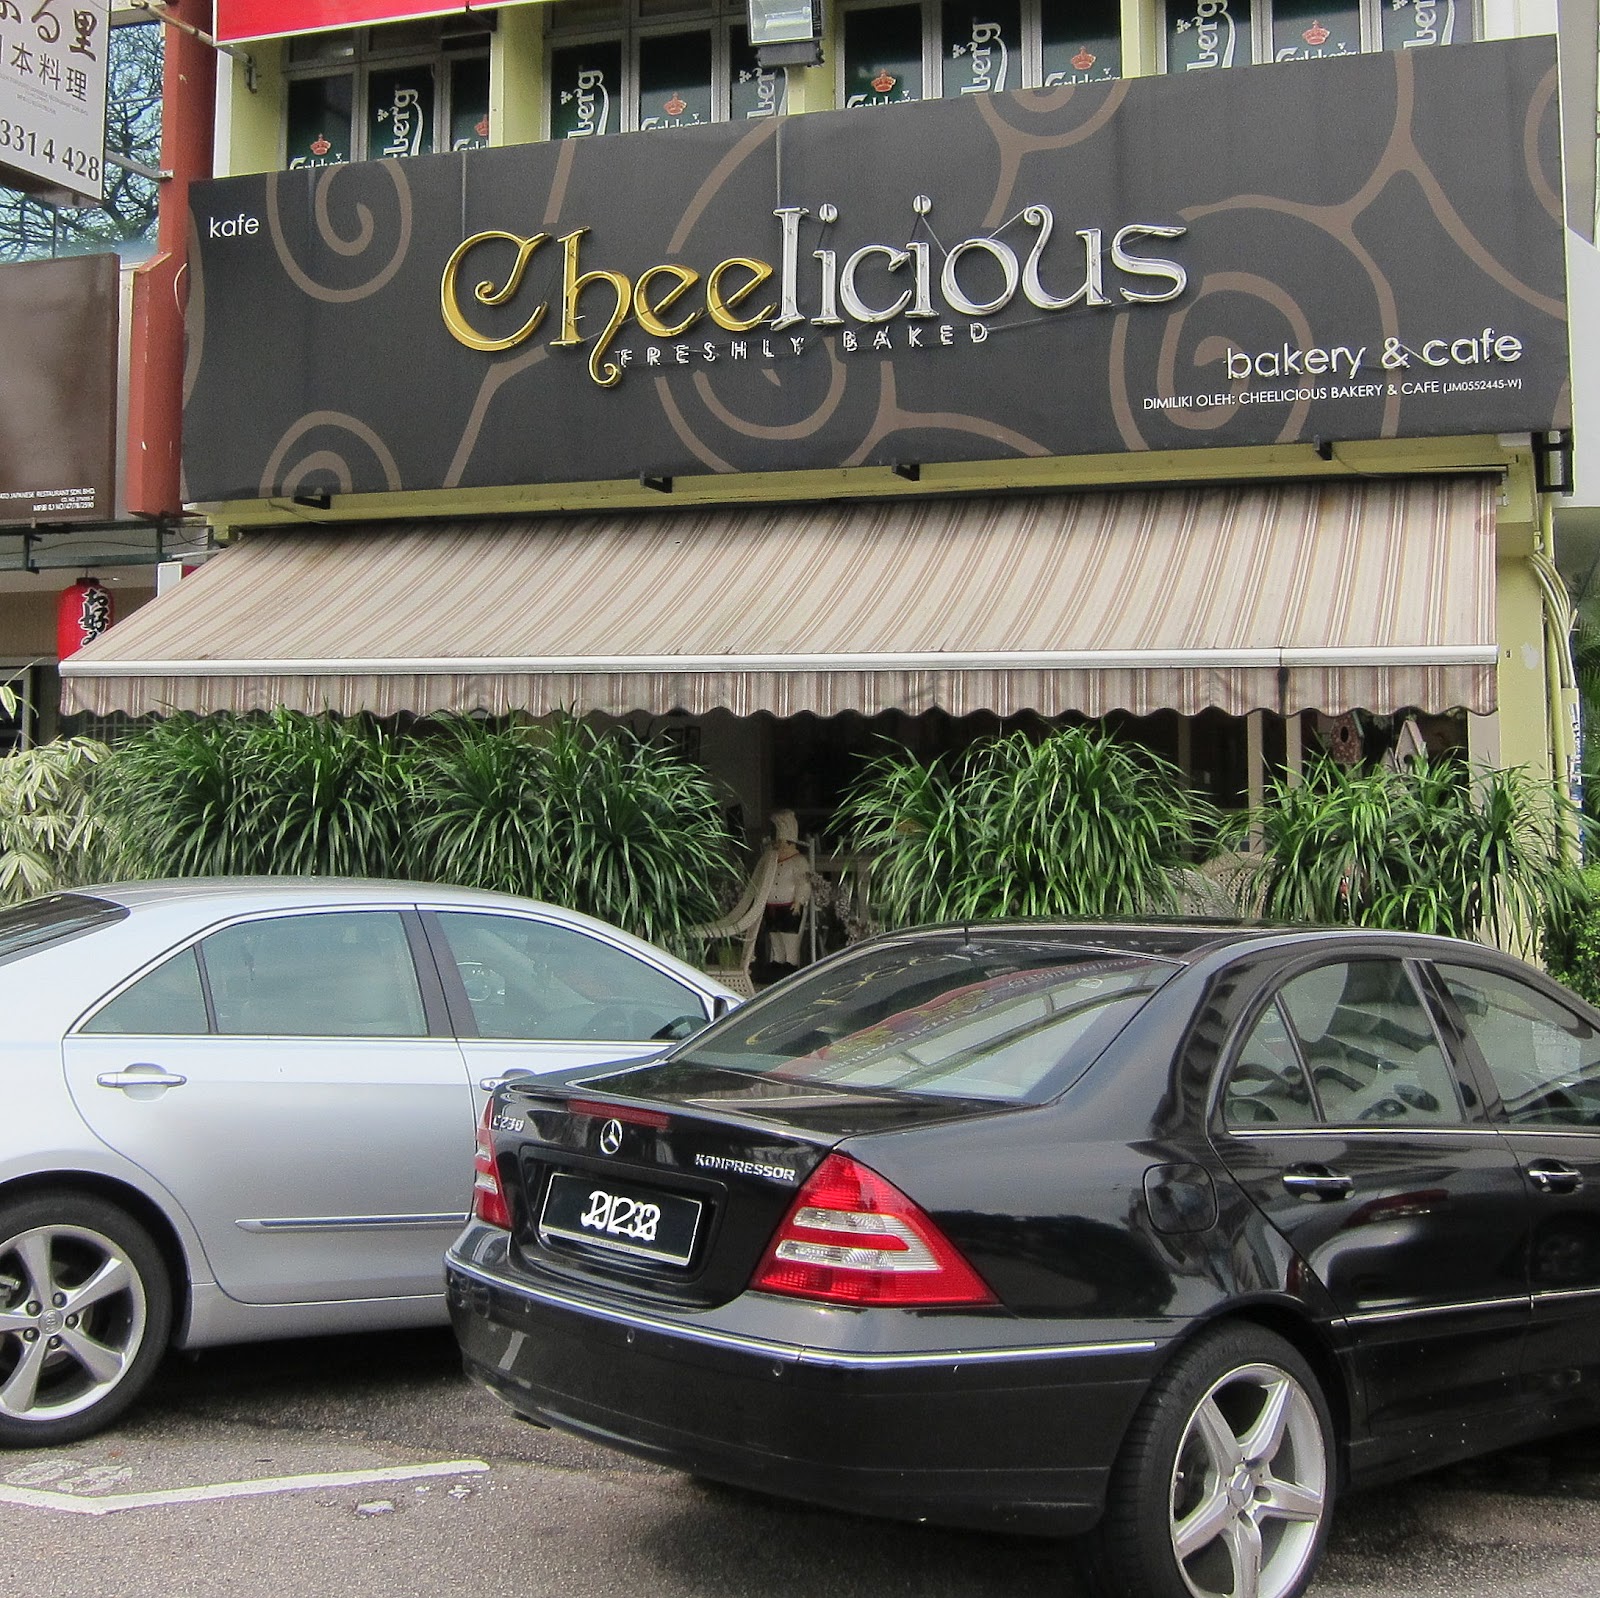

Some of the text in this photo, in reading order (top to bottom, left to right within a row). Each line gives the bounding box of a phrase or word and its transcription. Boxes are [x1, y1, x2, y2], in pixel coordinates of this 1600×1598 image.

[209, 213, 259, 238] kafe
[440, 194, 1188, 387] Cheelicious
[615, 322, 988, 368] FRESHLY BAKED
[1225, 328, 1522, 379] bakery & cafe
[1143, 396, 1193, 410] DIMILIKI
[1196, 394, 1236, 408] OLEH:
[1239, 387, 1327, 405] CHEELICIOUS
[1331, 384, 1383, 399] BAKERY
[1387, 384, 1398, 395] &
[1401, 381, 1440, 394] CAFE
[493, 1114, 525, 1132] C230
